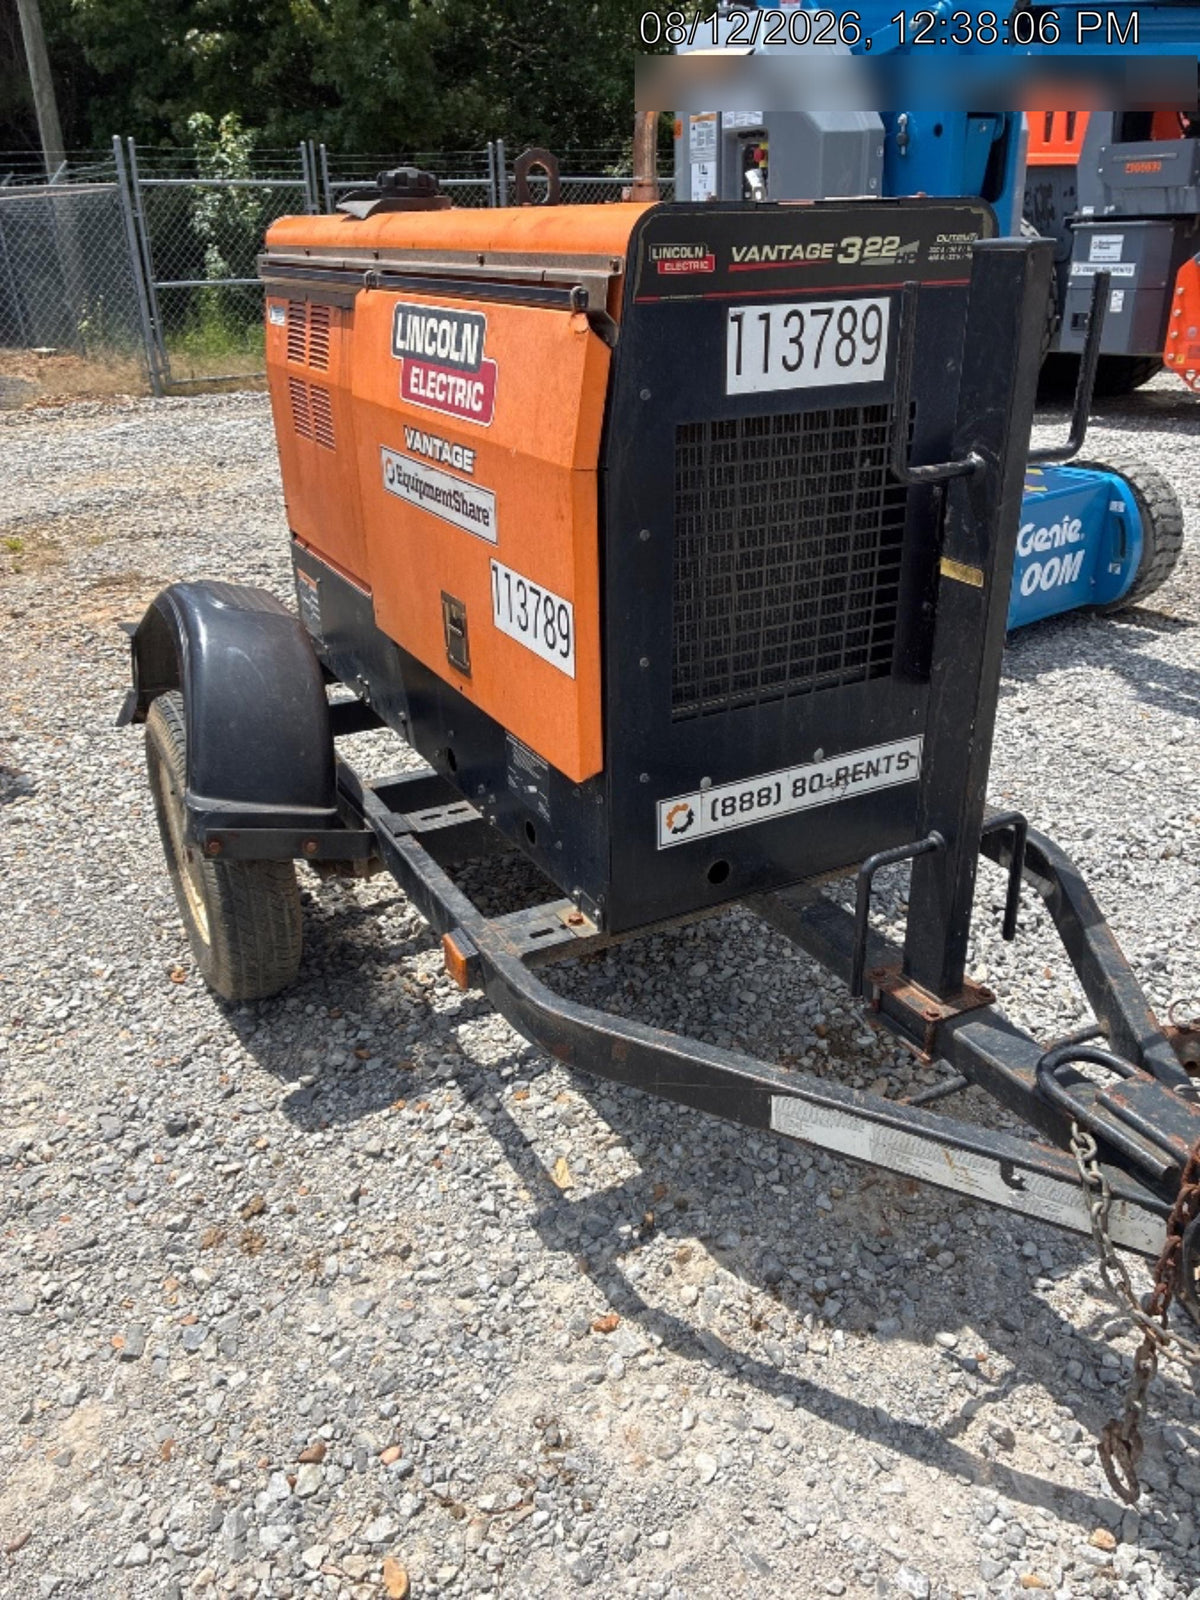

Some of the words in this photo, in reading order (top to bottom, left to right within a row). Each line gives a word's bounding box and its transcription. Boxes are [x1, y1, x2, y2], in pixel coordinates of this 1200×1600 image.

[651, 246, 704, 259] LINCOLN
[664, 260, 709, 271] ELECTRIC
[731, 243, 835, 262] VANTAGE
[837, 236, 901, 262] 322
[395, 312, 480, 366] LINCOLN
[730, 302, 884, 377] 113789
[409, 366, 485, 412] ELECTRIC
[404, 425, 476, 474] VANTAGE
[395, 463, 490, 527] EquipmentShare
[1016, 515, 1083, 557] Genie
[491, 563, 571, 658] 113789
[710, 781, 782, 822] (888)
[792, 750, 917, 797] 80-RENTS
